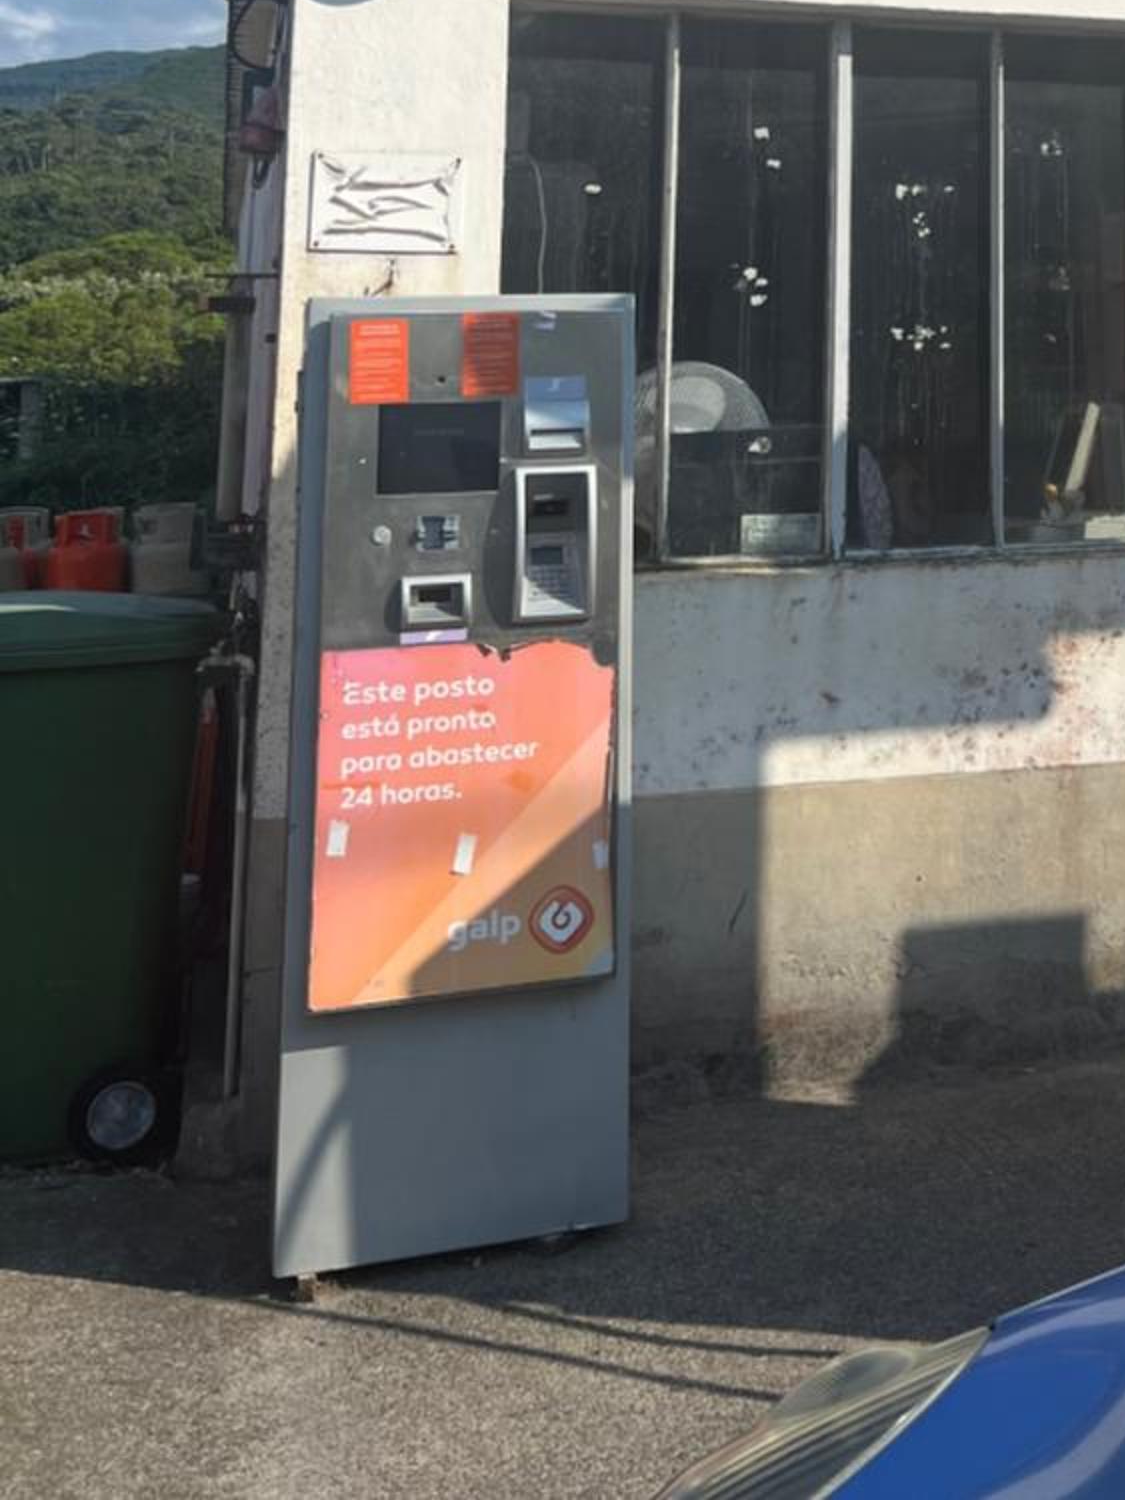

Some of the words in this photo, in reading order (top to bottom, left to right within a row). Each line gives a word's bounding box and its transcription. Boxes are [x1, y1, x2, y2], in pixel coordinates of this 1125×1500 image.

[342, 681, 407, 706] Este
[413, 675, 496, 707] posto
[341, 713, 401, 740] está
[407, 710, 497, 740] pronto
[340, 752, 403, 780] para
[409, 742, 540, 769] abastecer
[340, 782, 373, 809] 24
[380, 782, 463, 805] horas.
[447, 910, 522, 952] galp
